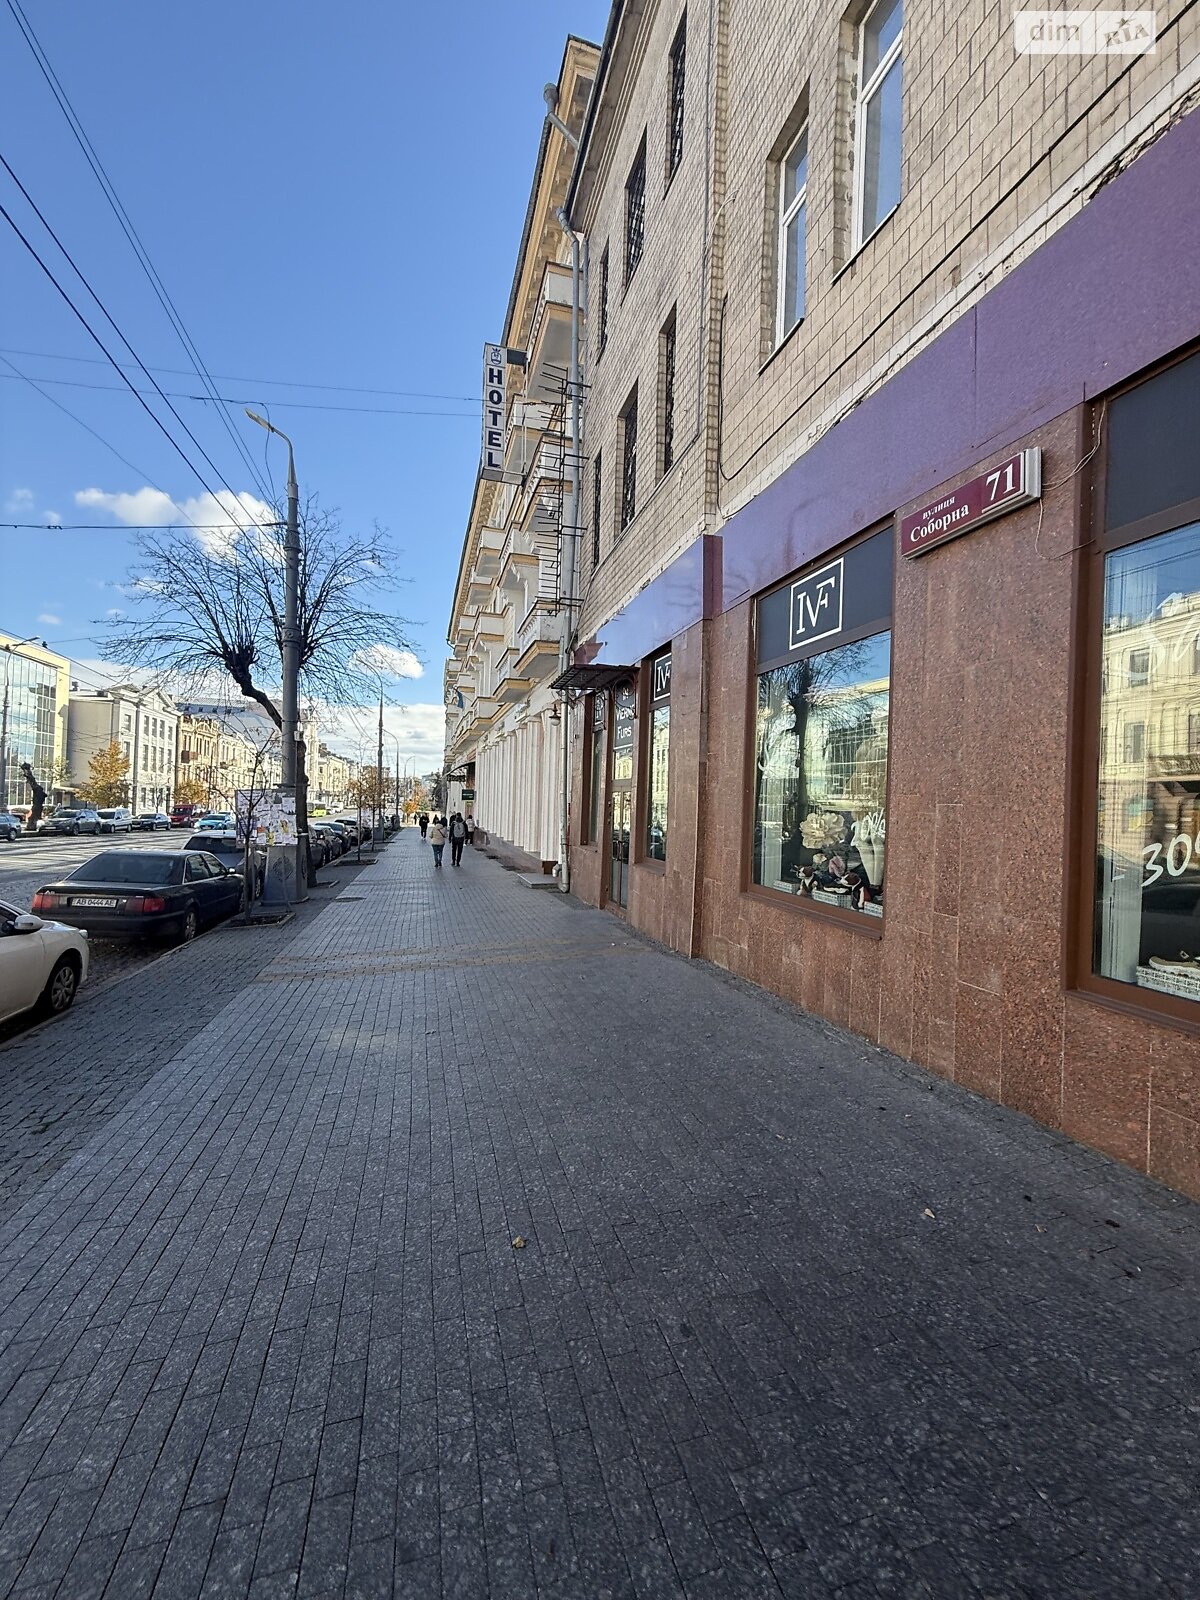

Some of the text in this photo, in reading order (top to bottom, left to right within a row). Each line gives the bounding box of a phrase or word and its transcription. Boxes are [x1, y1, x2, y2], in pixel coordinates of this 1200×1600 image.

[486, 367, 503, 469] HOTEL
[985, 462, 1016, 502] 71
[909, 503, 970, 543] Соборна
[921, 495, 956, 520] вулиця
